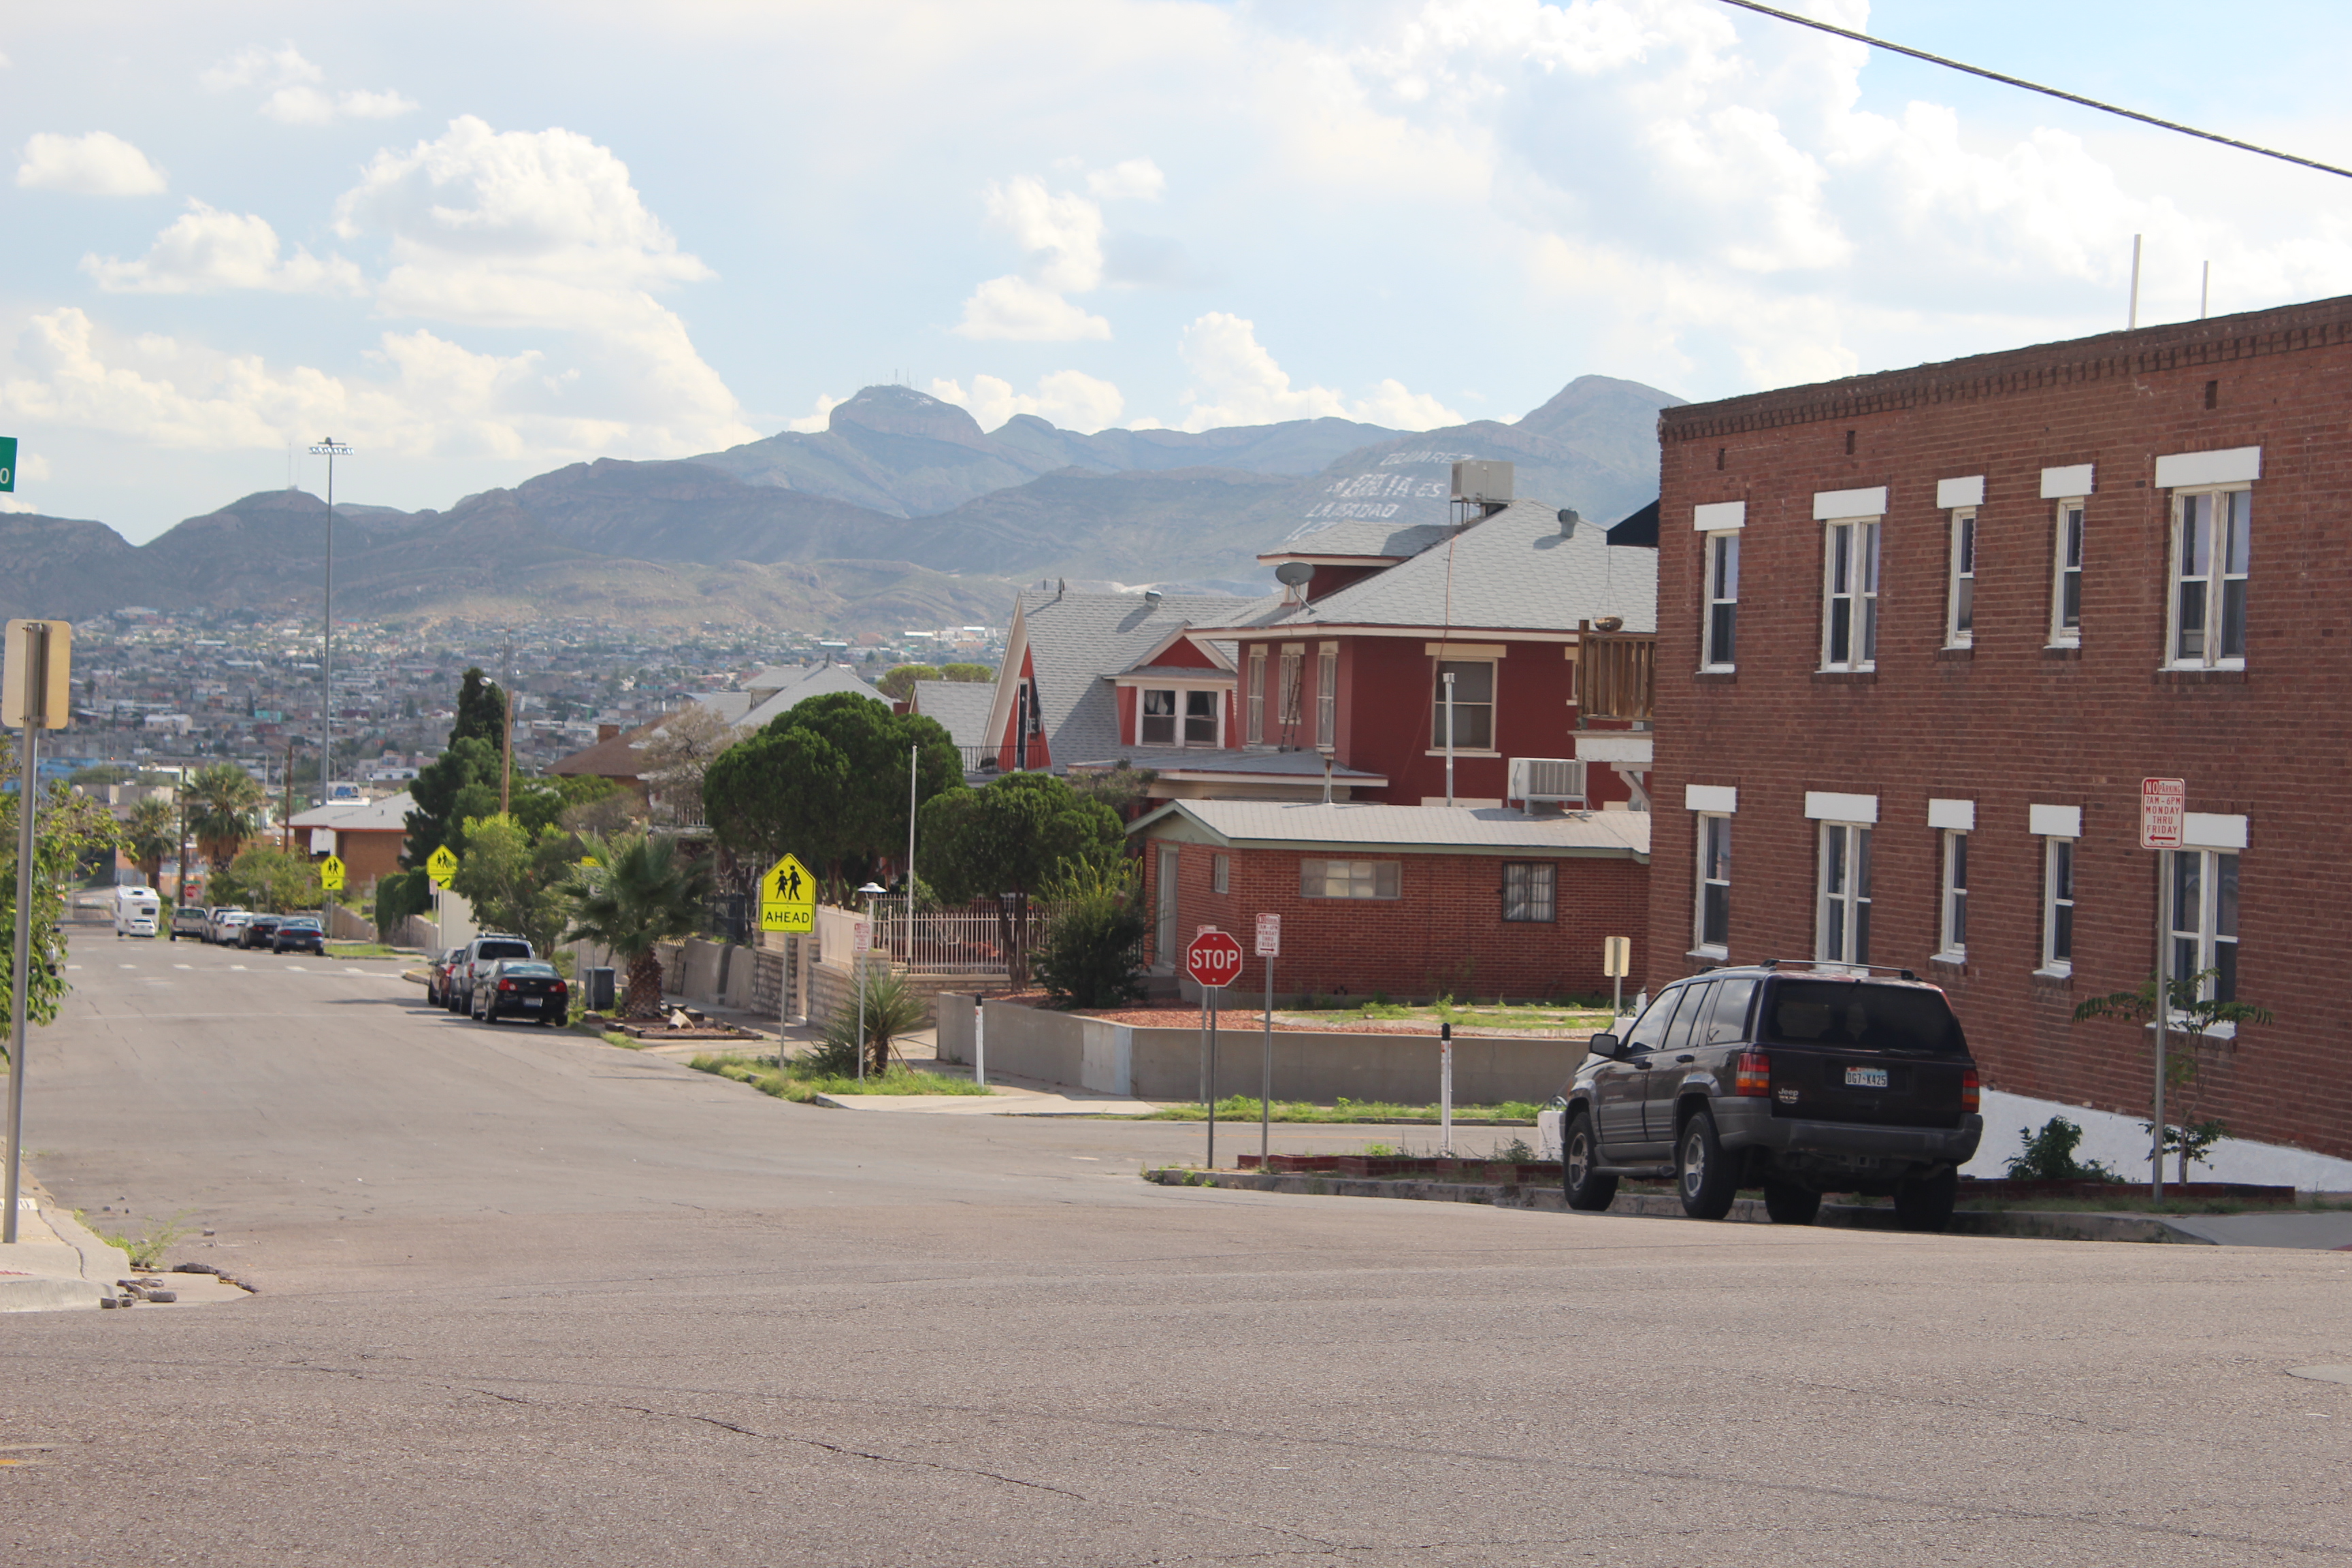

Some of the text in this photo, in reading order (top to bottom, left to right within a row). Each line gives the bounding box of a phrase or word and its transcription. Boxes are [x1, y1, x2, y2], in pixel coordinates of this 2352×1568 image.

[1415, 483, 1447, 497] ES
[2146, 781, 2181, 794] NO PARKING
[2166, 796, 2180, 805] 6PM
[2146, 806, 2179, 815] MONDAY
[2153, 816, 2173, 825] THRU
[2146, 825, 2178, 834] FRIDAY
[765, 911, 810, 924] AHEAD
[1191, 949, 1239, 970] STOP
[1778, 1088, 1799, 1096] Jeep
